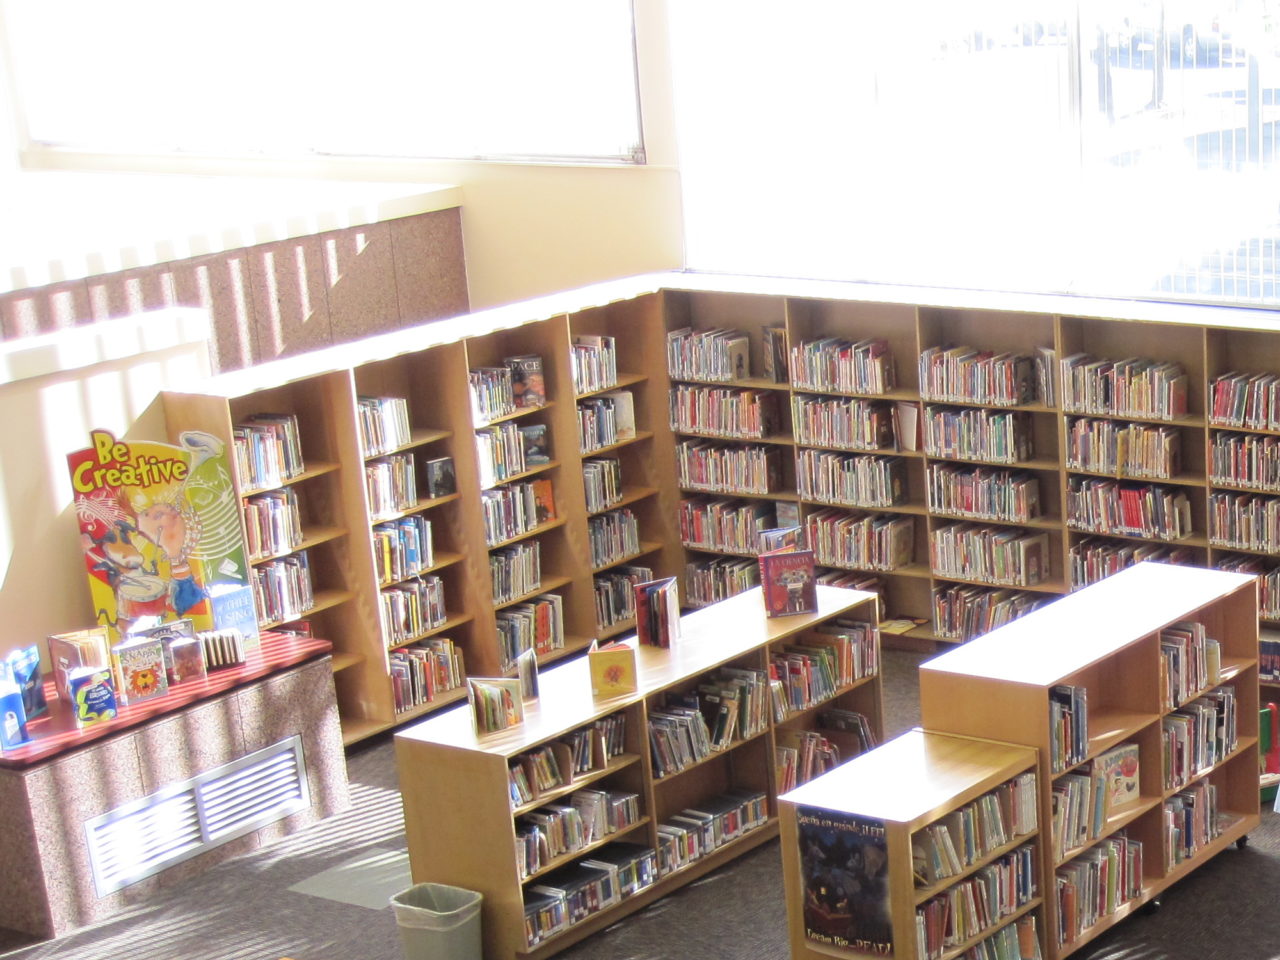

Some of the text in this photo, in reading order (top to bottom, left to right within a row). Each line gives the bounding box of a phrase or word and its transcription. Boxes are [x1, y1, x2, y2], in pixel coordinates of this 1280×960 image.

[503, 359, 540, 371] SPACE
[93, 431, 128, 465] Be
[73, 456, 187, 493] Creative
